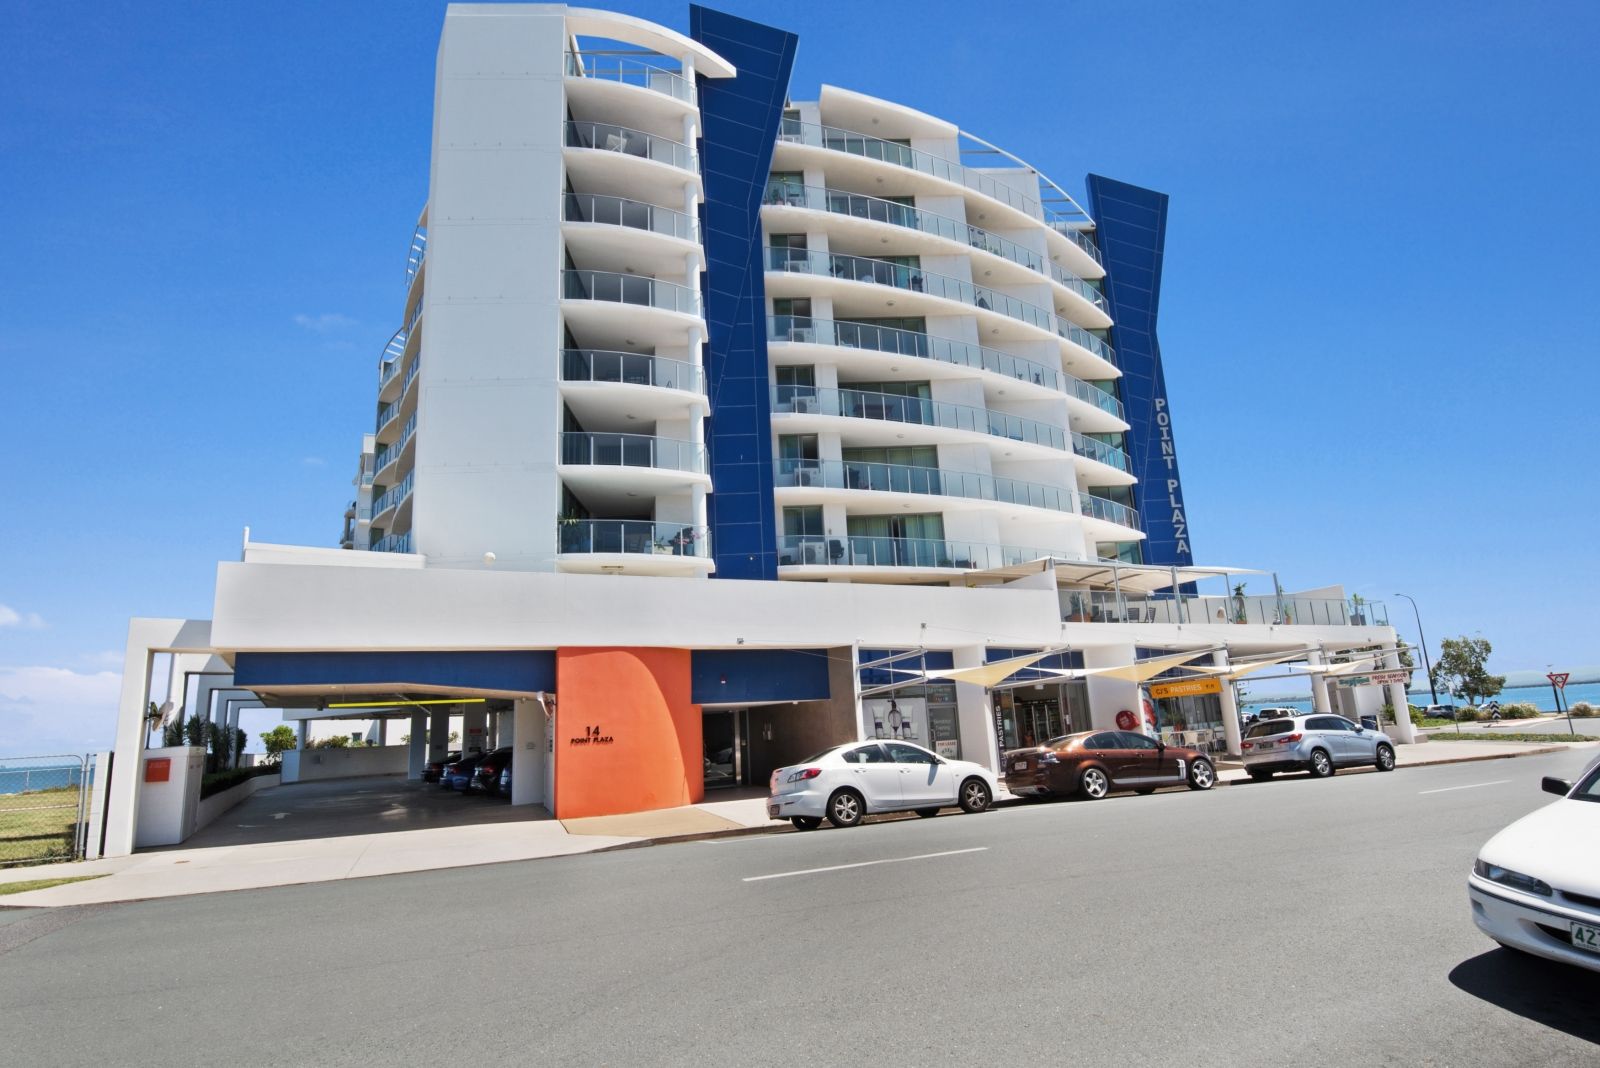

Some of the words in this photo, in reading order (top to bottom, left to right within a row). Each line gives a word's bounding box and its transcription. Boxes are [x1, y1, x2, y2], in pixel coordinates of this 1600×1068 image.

[1155, 398, 1174, 470] POINT
[1167, 479, 1190, 554] PLAZA
[1170, 684, 1202, 693] PASTRIES
[586, 725, 600, 737] 14
[995, 705, 1005, 747] PASTRIES
[1575, 926, 1600, 947] 42
